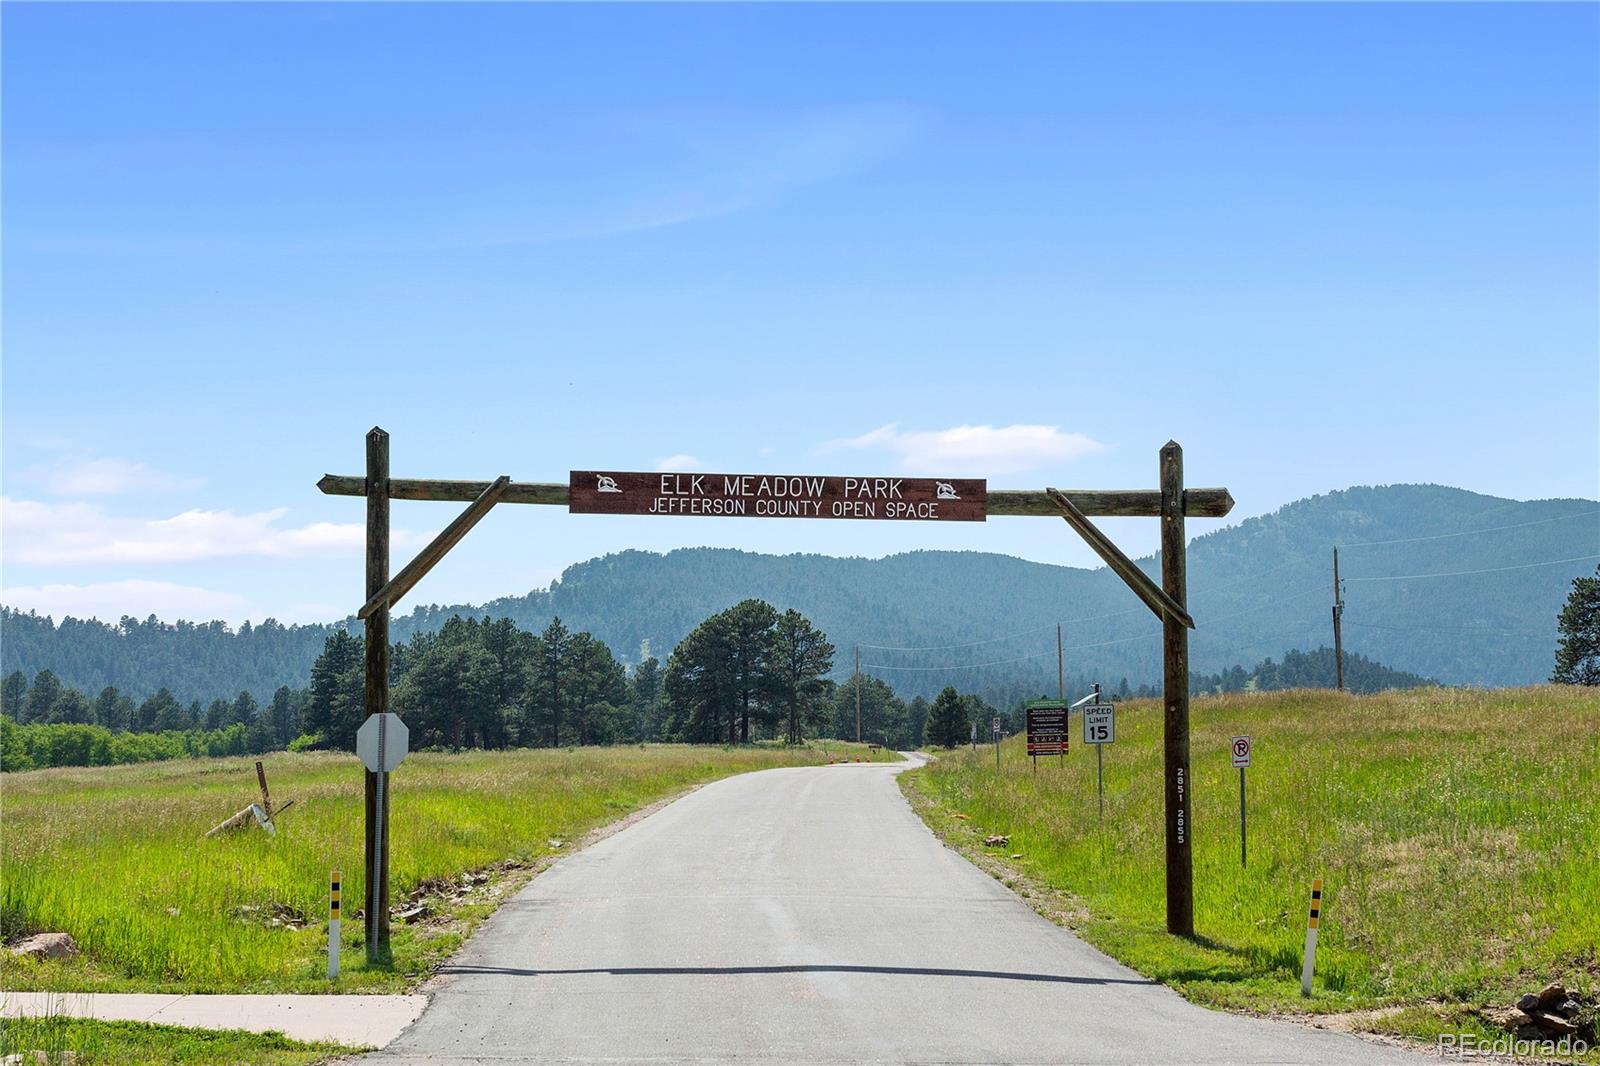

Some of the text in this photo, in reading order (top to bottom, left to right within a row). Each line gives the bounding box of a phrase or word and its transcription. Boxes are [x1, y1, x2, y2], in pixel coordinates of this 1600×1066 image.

[660, 474, 903, 499] ELK MEADOW PARK
[649, 497, 939, 518] JEFFERSON COUNTY OPEN SPACE
[1090, 726, 1109, 740] 15
[1177, 809, 1185, 844] 2855
